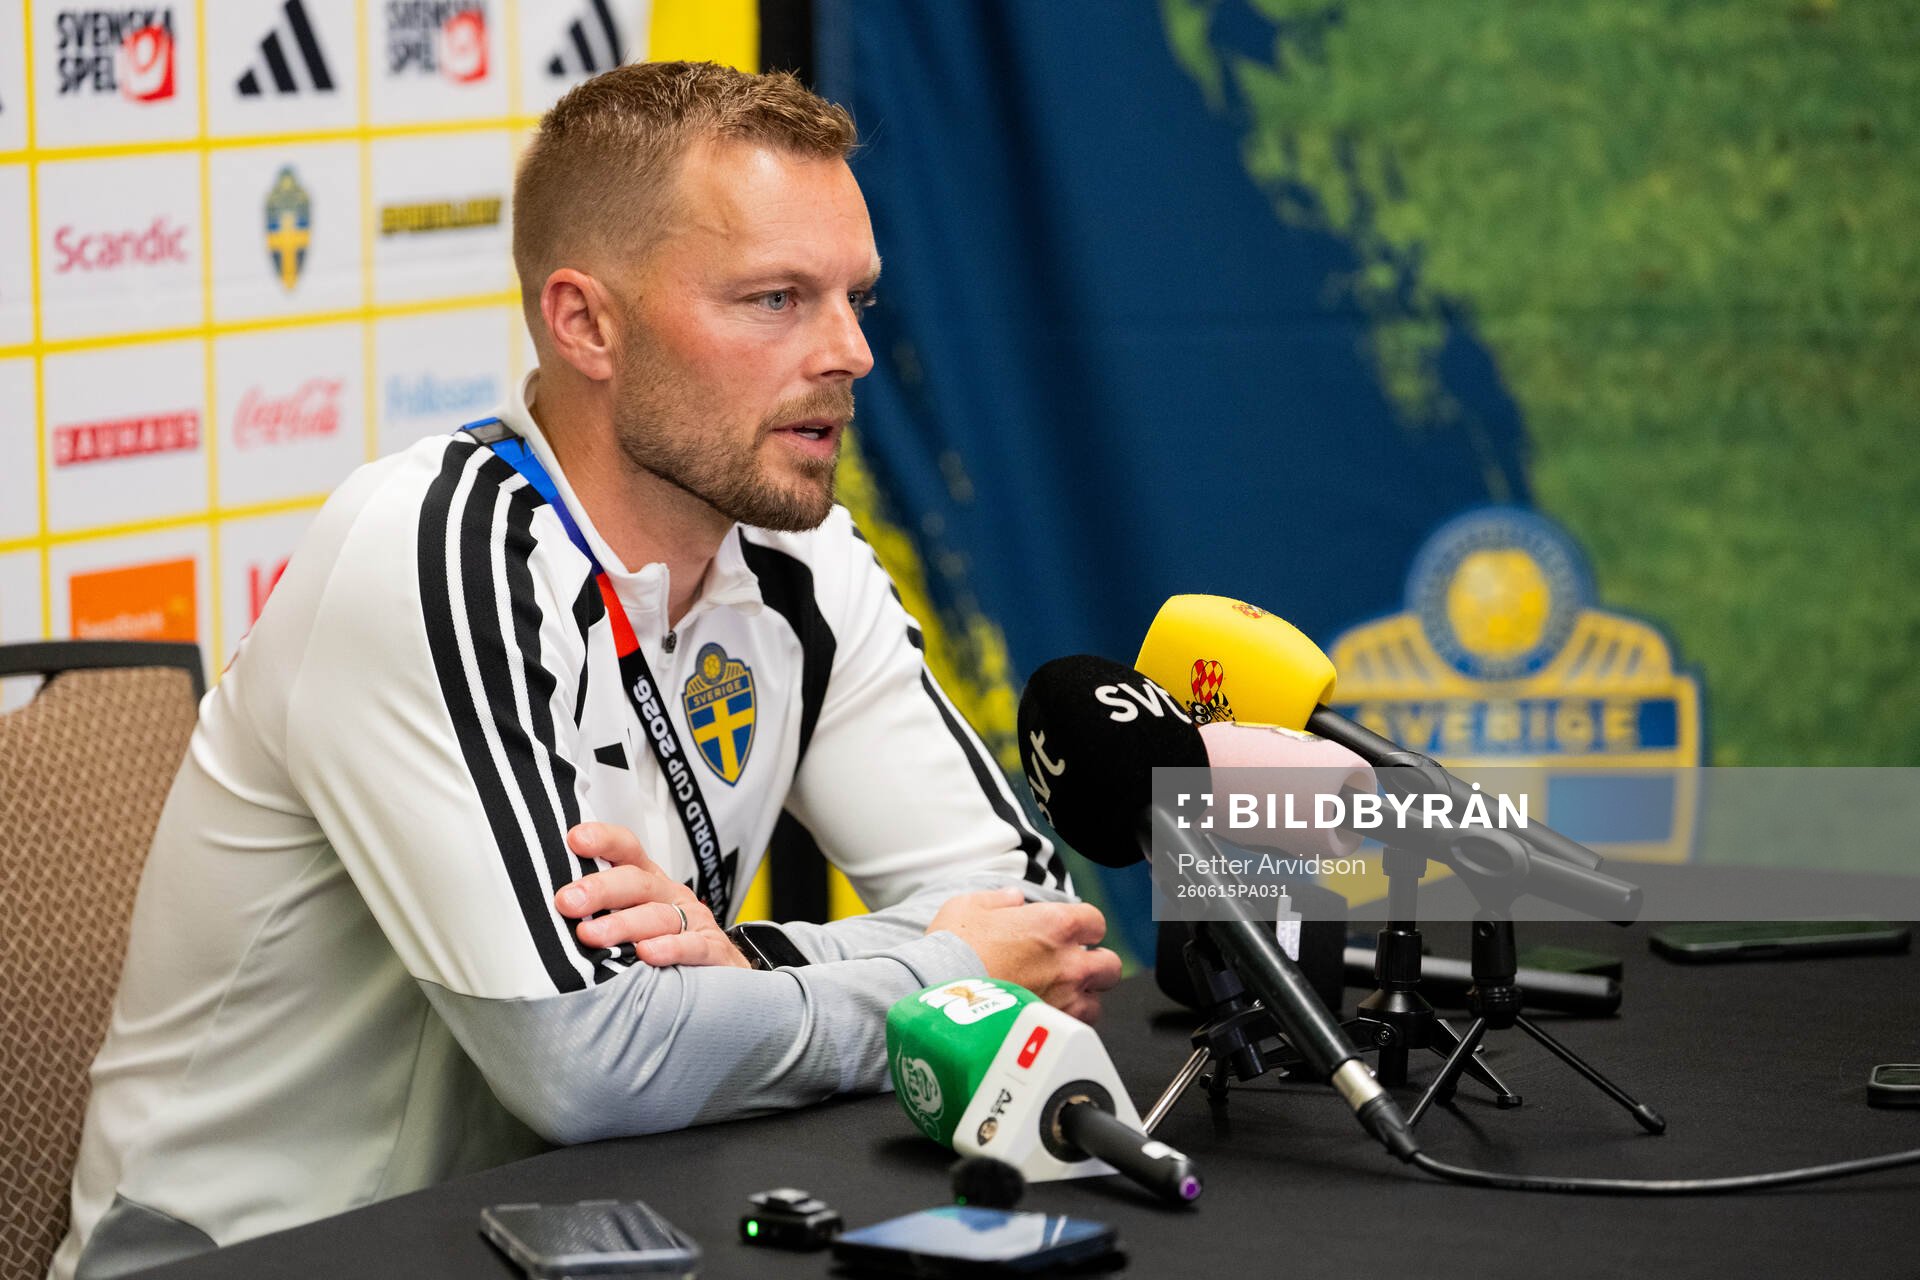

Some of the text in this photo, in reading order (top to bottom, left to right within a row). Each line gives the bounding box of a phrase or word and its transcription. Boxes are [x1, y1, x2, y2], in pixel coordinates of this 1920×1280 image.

[57, 56, 117, 94] SPEL
[54, 216, 187, 274] Scandic
[57, 416, 197, 464] BAUHAUS
[692, 679, 742, 707] SVERIGE
[668, 758, 694, 802] CUP
[685, 801, 719, 878] WORLD
